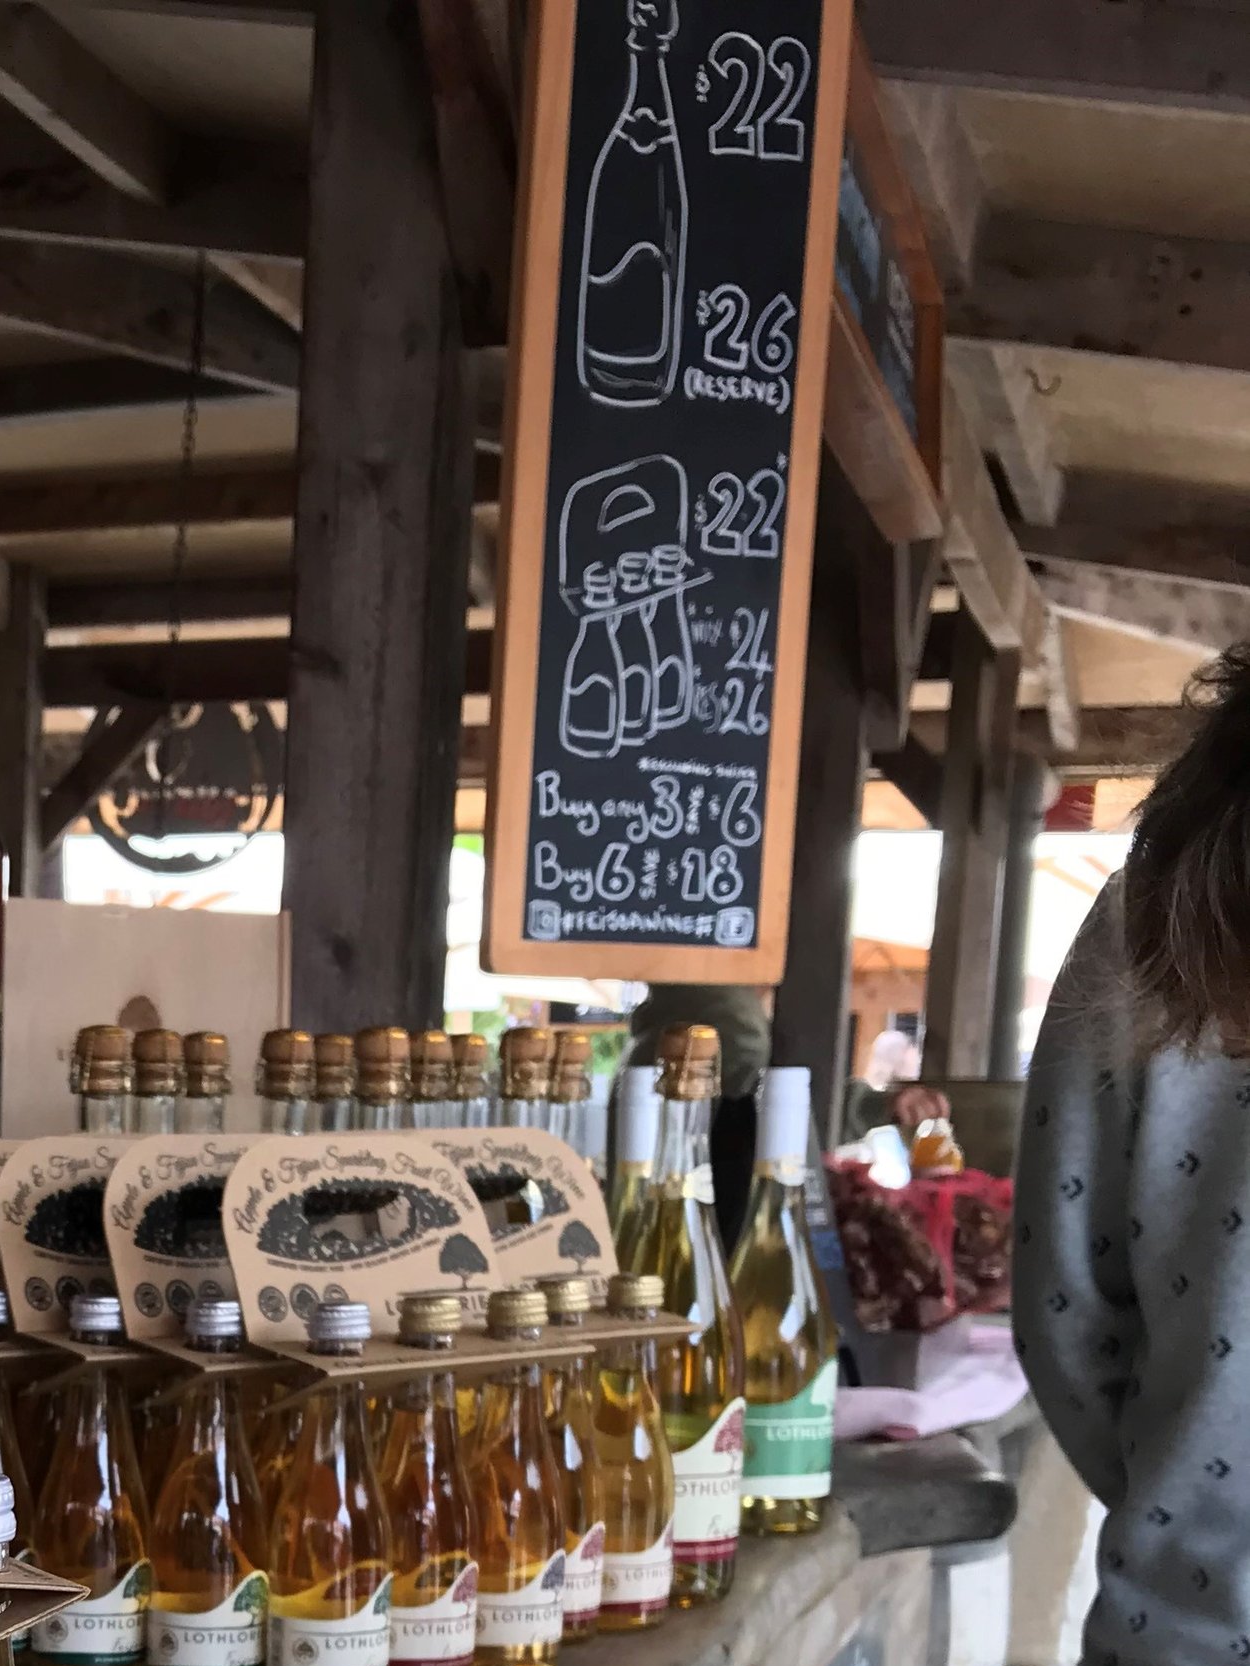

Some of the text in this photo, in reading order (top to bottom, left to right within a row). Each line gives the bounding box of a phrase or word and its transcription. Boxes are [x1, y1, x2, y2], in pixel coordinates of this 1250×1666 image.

[535, 769, 600, 836] Buy
[601, 800, 650, 844] any
[650, 774, 684, 840] 3
[534, 840, 594, 902] Buy
[596, 841, 636, 901] 6
